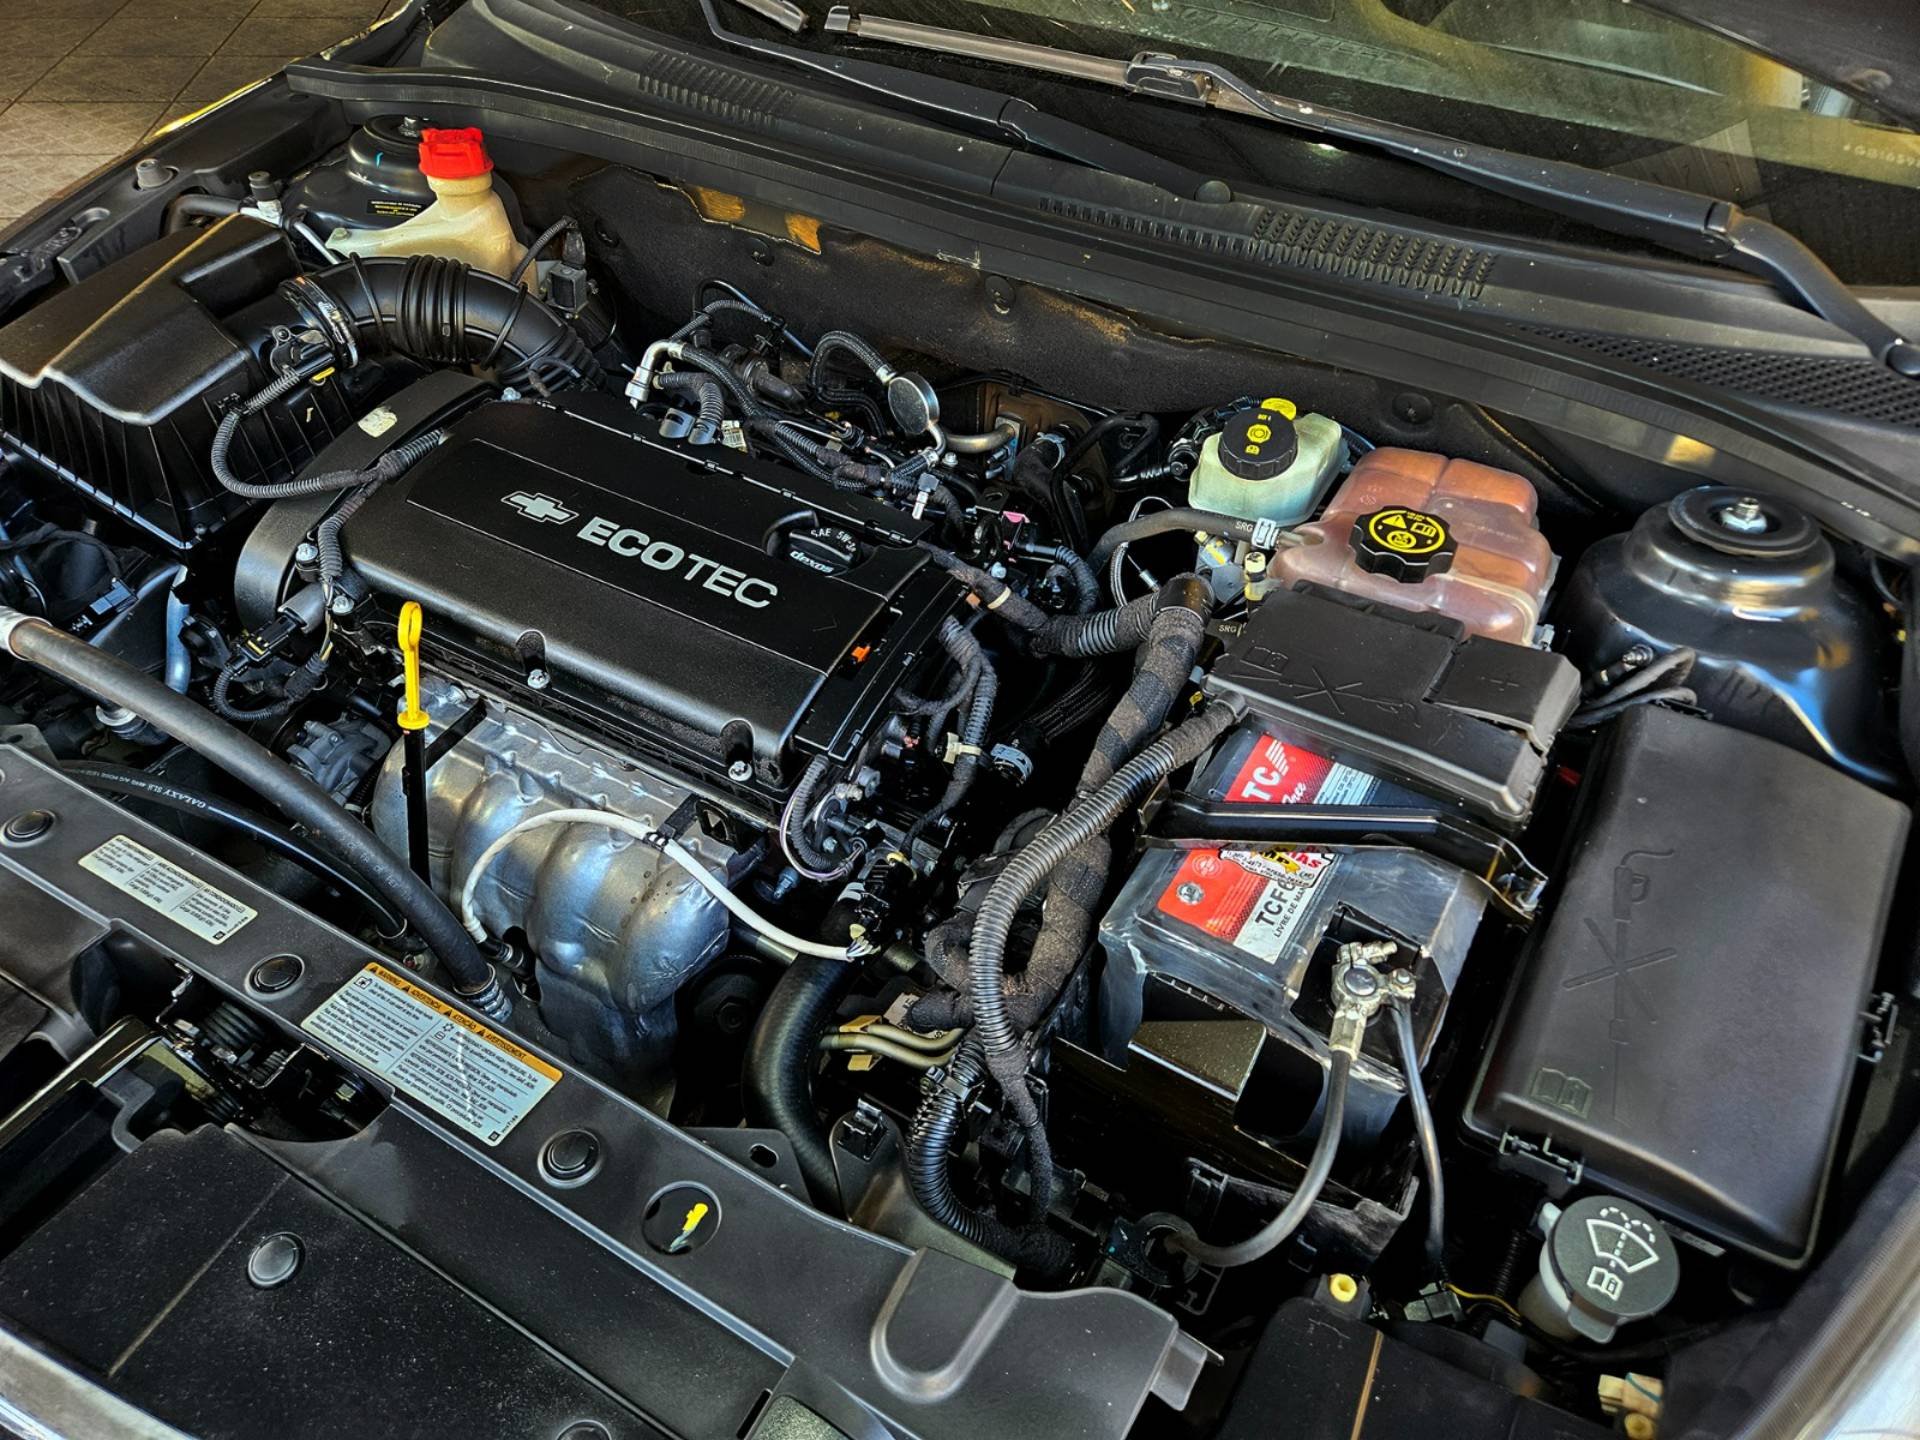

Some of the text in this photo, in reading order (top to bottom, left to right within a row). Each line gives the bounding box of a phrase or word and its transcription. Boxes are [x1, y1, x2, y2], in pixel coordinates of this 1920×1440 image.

[810, 527, 832, 538] SAE
[1235, 520, 1254, 533] SRG
[576, 516, 778, 608] ECOTEC
[789, 550, 834, 573] dexos
[1241, 766, 1281, 801] TC
[162, 788, 207, 809] GALAXY
[1273, 887, 1306, 939] LIVRE DE MAN
